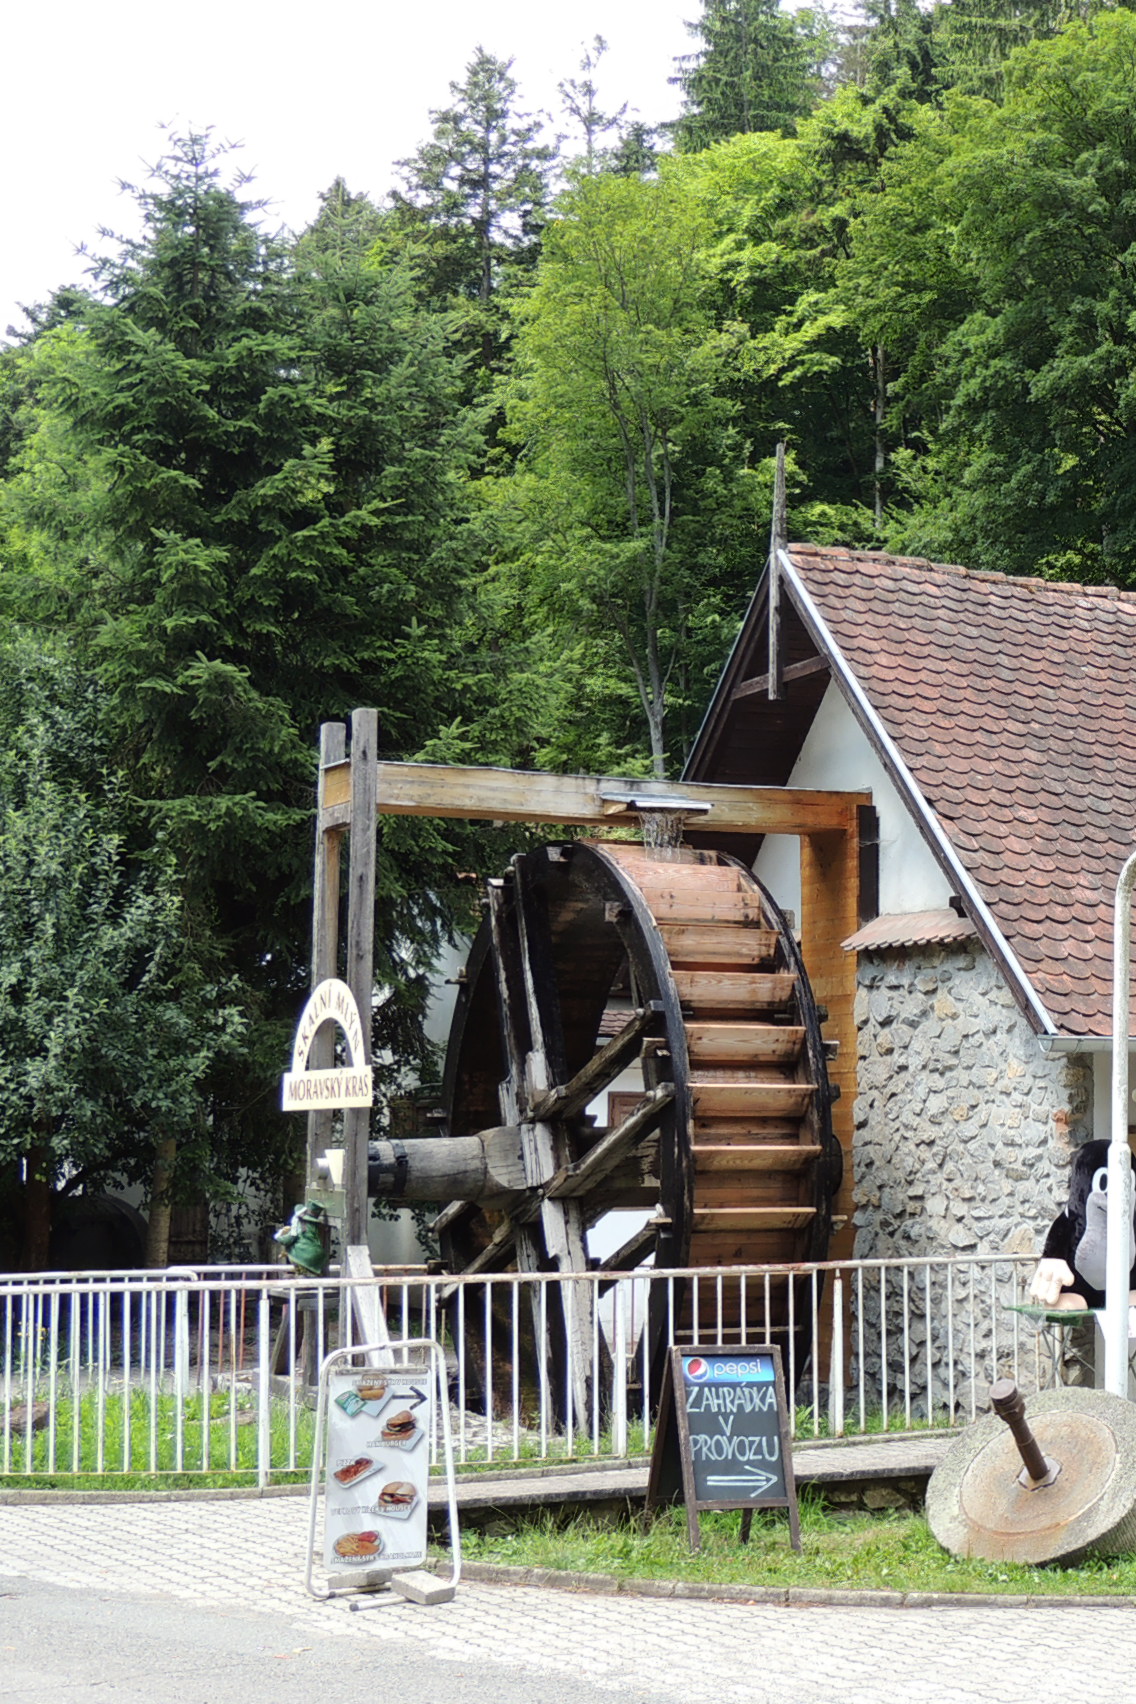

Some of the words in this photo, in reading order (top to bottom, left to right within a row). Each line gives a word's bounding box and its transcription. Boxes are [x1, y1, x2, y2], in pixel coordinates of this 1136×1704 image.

[288, 1070, 343, 1101] MORAVSKÝ
[344, 1074, 369, 1098] KRAS
[713, 1359, 762, 1378] pepsi
[685, 1382, 778, 1414] ZAHRÁDKA
[718, 1414, 735, 1437] V
[688, 1433, 780, 1463] PROVOZU
